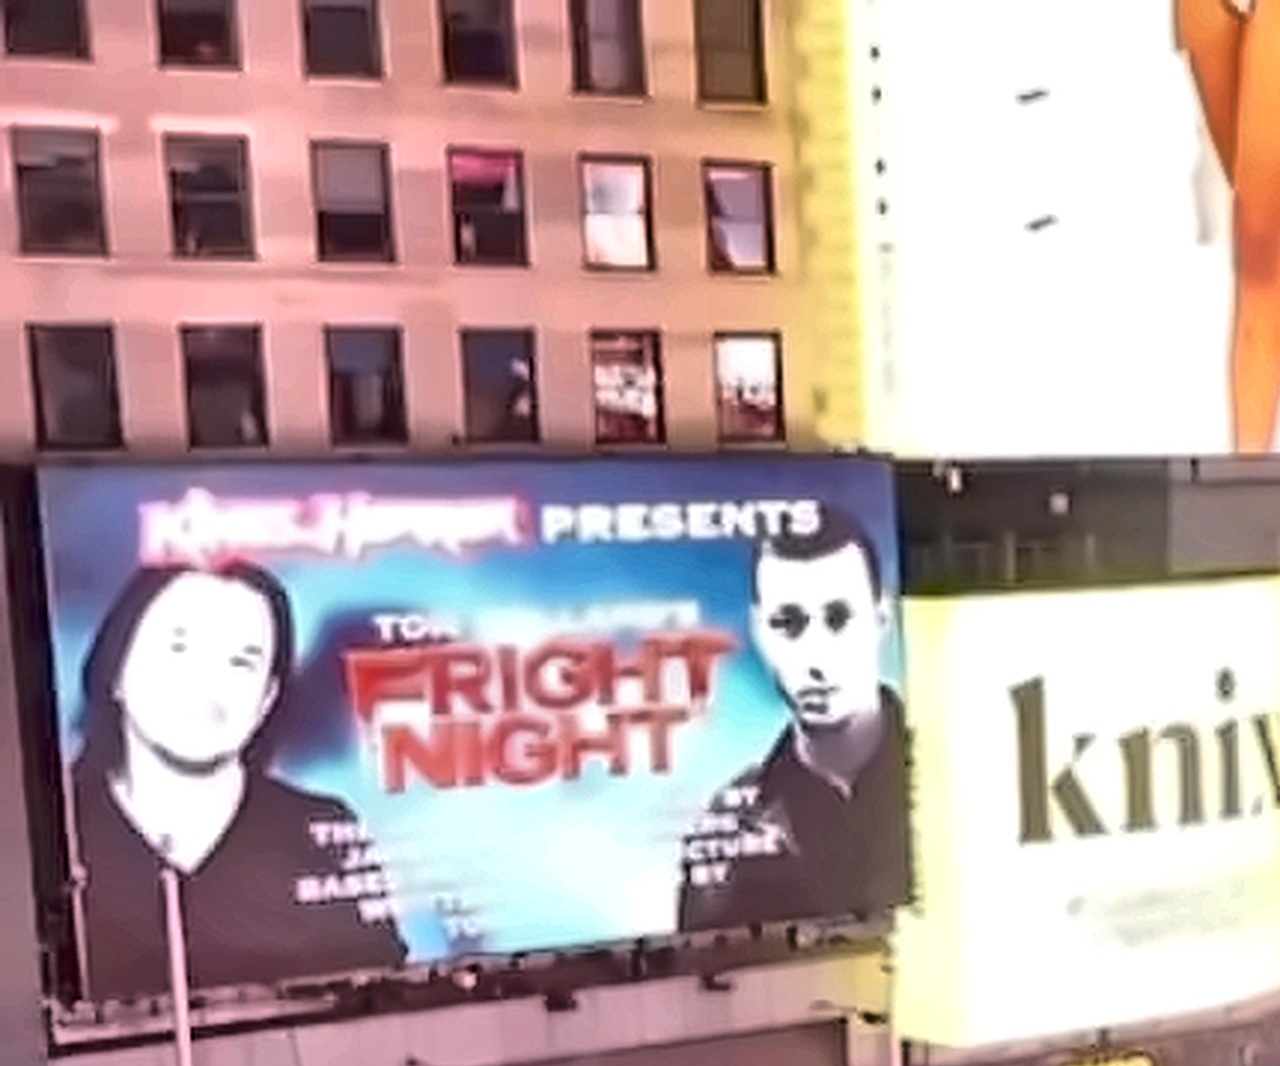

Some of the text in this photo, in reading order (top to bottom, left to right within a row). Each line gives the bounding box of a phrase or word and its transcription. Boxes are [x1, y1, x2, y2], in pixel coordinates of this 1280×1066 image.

[540, 500, 820, 544] PRESENTS
[342, 630, 736, 725] FRIGHT
[380, 705, 690, 794] NIGHT
